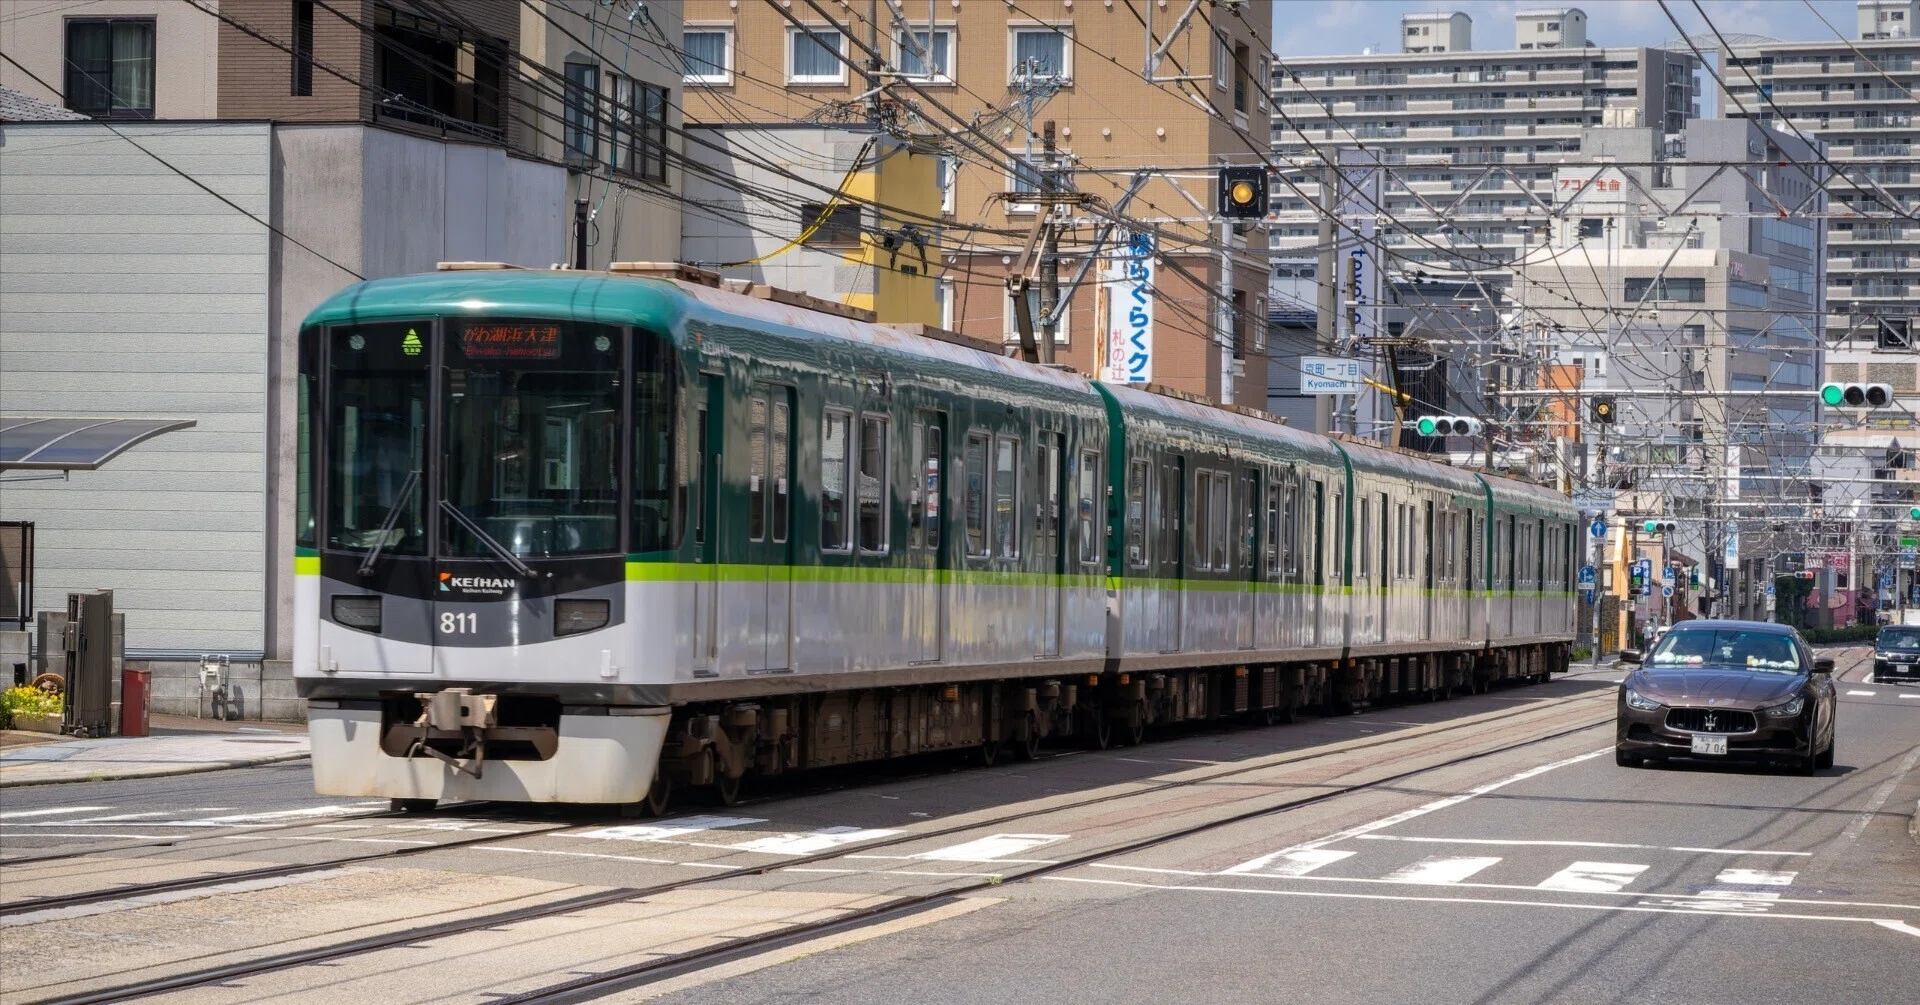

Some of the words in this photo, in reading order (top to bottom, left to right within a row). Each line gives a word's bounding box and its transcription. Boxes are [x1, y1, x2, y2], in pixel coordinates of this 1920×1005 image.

[1111, 328, 1126, 381] 札の辻
[1305, 363, 1357, 376] 京町一丁目
[1307, 379, 1347, 389] Kyomachi
[1633, 567, 1642, 576] P
[451, 577, 516, 588] KEIHAN
[440, 611, 477, 634] 811
